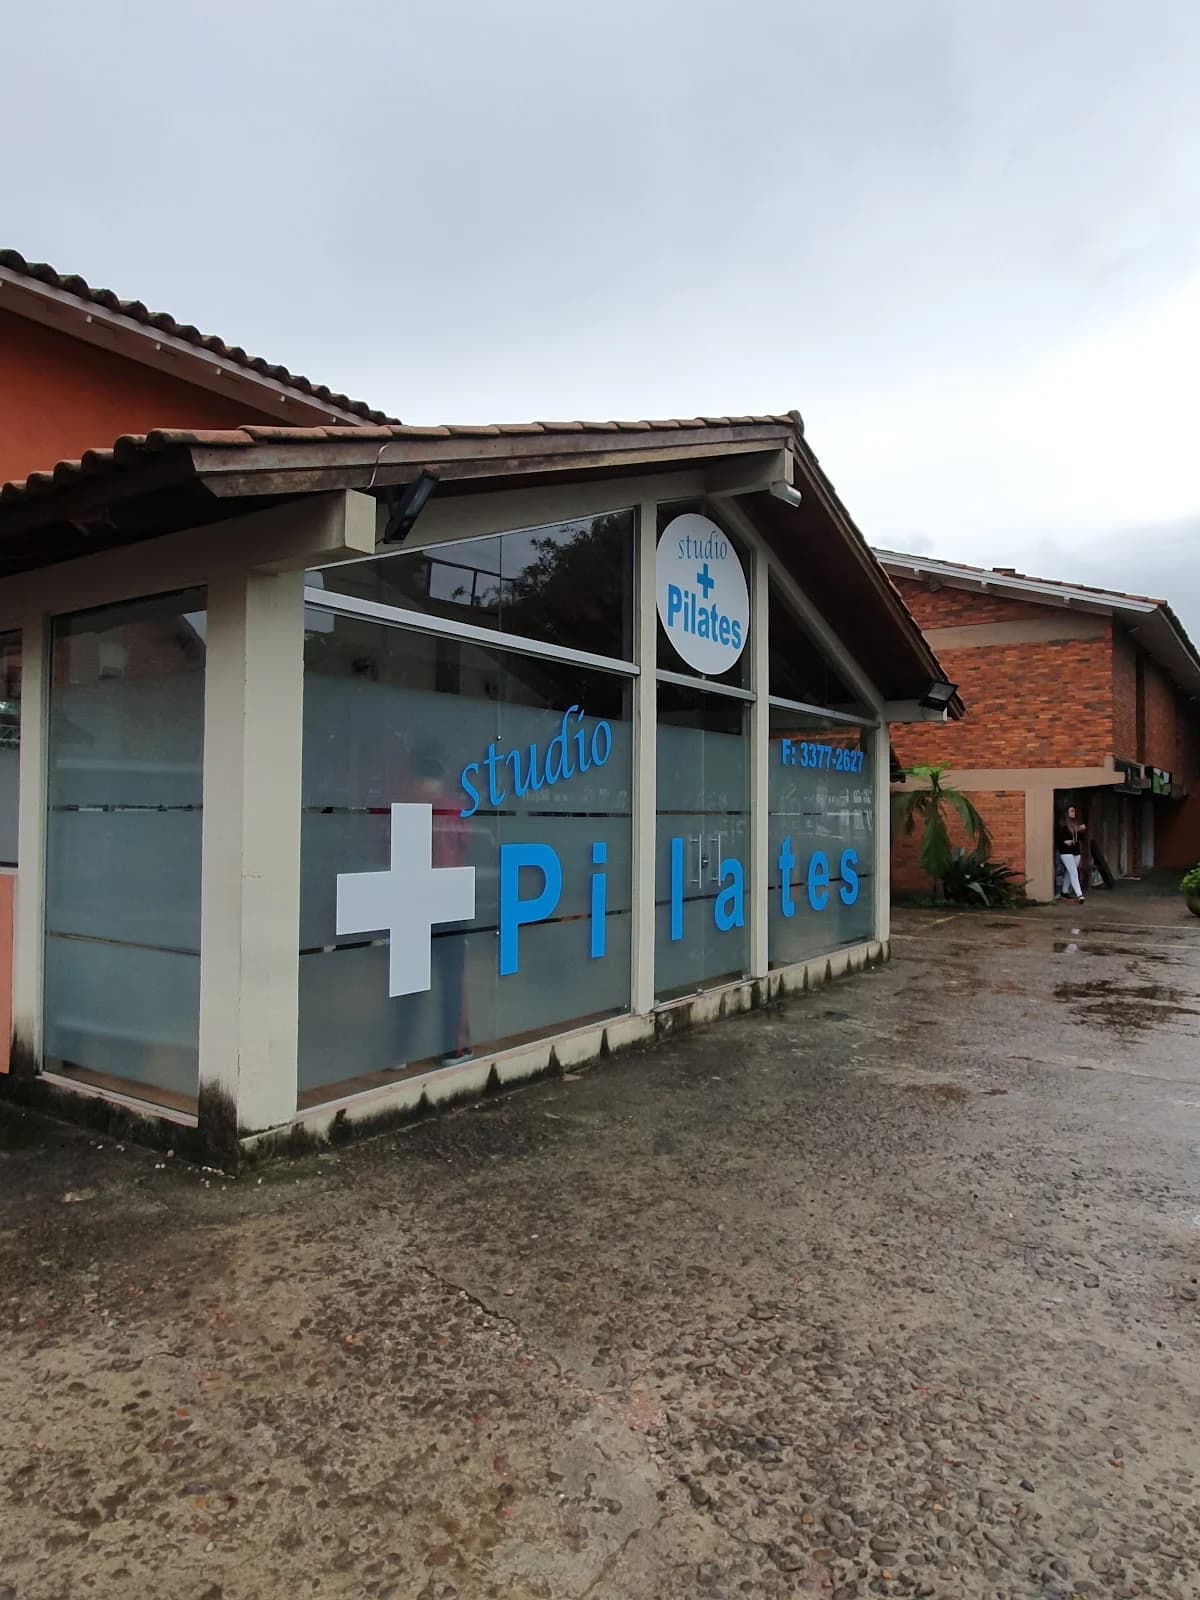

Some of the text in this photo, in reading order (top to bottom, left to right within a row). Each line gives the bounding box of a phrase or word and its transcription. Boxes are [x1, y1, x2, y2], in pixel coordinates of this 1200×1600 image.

[678, 530, 728, 560] studio
[667, 583, 742, 650] Pilates
[459, 704, 612, 818] studio
[782, 739, 864, 773] F: 3377-2627
